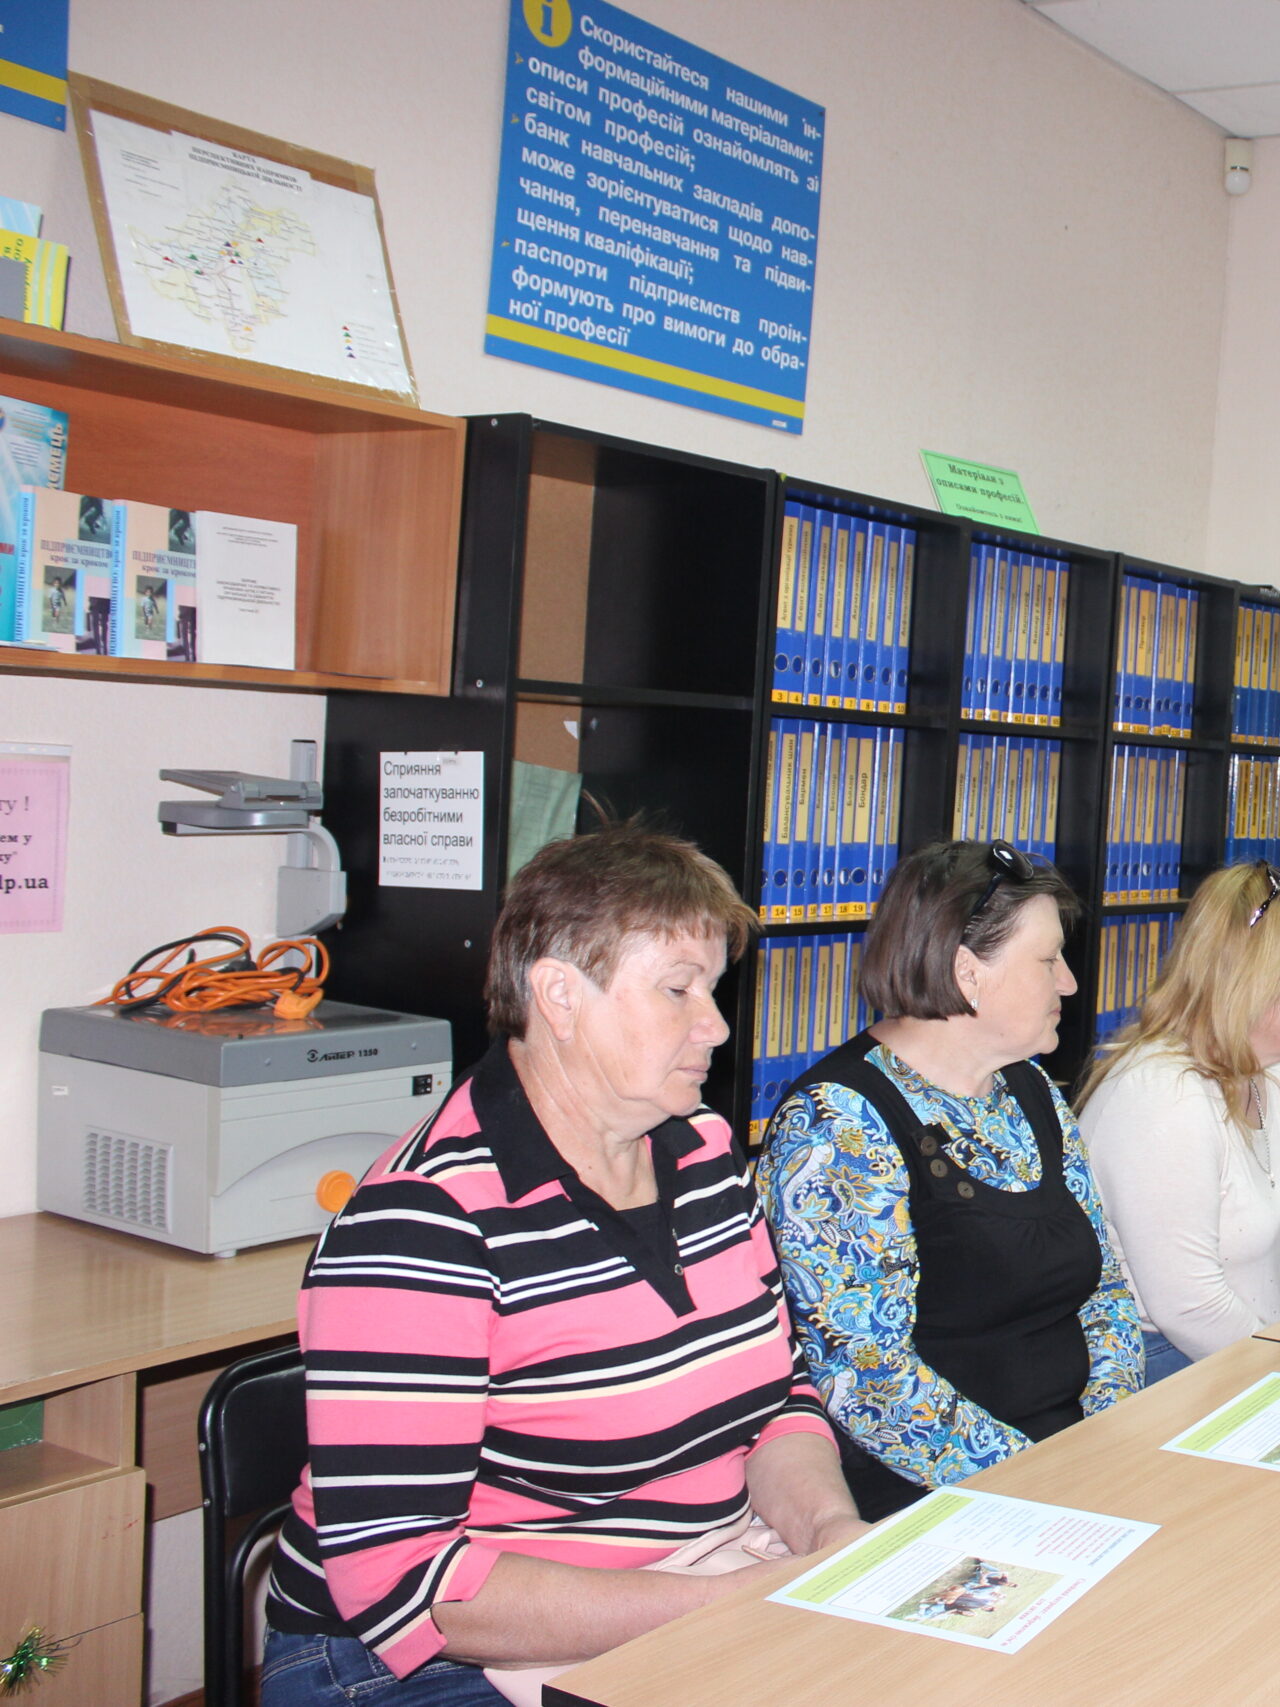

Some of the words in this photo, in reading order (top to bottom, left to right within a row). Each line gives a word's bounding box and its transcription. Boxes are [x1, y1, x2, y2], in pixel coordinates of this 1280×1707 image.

[578, 46, 708, 118] формаційними
[711, 107, 813, 165] матеріалами:
[580, 15, 710, 90] Скористайтеся
[726, 87, 788, 127] нашими
[802, 117, 822, 139] ін-
[526, 87, 591, 127] світом
[604, 118, 696, 173] професій;
[528, 56, 589, 95] описи
[598, 85, 684, 136] професій
[692, 127, 799, 185] ознайомлять
[806, 175, 819, 192] зі
[522, 147, 576, 180] може
[586, 170, 719, 234] зорієнтуватися
[728, 225, 773, 255] щодо
[781, 245, 814, 268] нав-
[524, 113, 570, 148] банк
[581, 138, 683, 193] навчальних
[693, 183, 764, 224] закладів
[771, 213, 816, 242] допо-
[516, 206, 580, 243] щення
[585, 231, 695, 284] кваліфікації;
[520, 176, 581, 217] чання,
[598, 204, 719, 262] перенавчання
[734, 254, 751, 273] та
[765, 265, 812, 293] підви-
[508, 297, 542, 322] ної
[544, 310, 630, 348] професії
[512, 265, 614, 314] формують
[622, 301, 655, 326] про
[663, 315, 727, 348] вимоги
[732, 337, 755, 356] до
[761, 344, 806, 371] обра-
[514, 237, 608, 283] паспорти
[629, 274, 741, 325] підприємств
[759, 317, 807, 345] проін-
[384, 761, 441, 779] Сприяння
[384, 786, 480, 803] започаткуванню
[781, 762, 792, 839] Балансувальник
[799, 768, 807, 805] Бармен
[858, 772, 868, 808] Бондар
[383, 807, 463, 825] безробітними
[383, 831, 428, 845] власної
[431, 835, 473, 850] справи
[775, 907, 785, 916] 14
[823, 905, 832, 913] 17
[853, 904, 864, 912] 19
